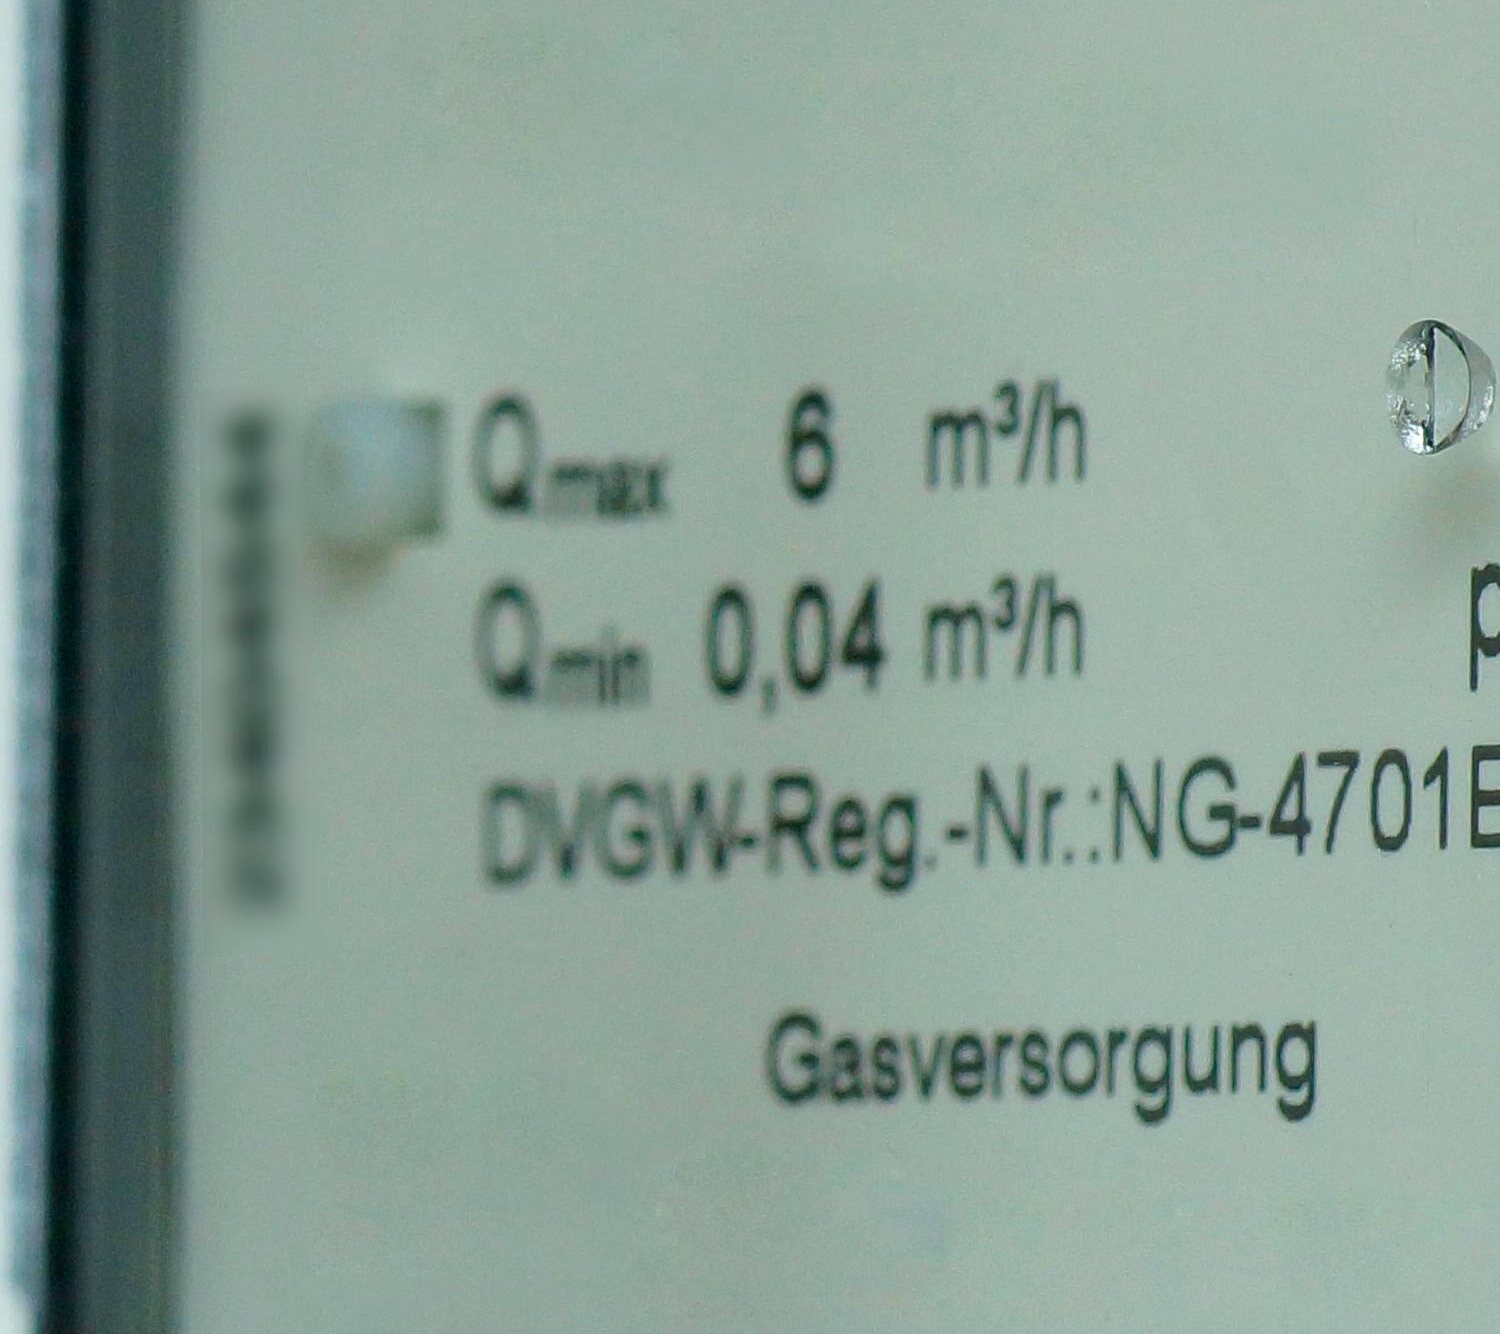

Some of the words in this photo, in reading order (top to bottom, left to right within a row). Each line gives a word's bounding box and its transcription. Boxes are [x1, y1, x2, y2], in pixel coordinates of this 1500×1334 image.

[474, 393, 670, 521] Qmax
[784, 387, 838, 505] 6
[925, 380, 1088, 490] m³/h
[474, 583, 650, 709] Qmin
[702, 579, 888, 717] 0,04
[922, 576, 1085, 682] m³/h
[764, 1010, 1316, 1126] Gasversorgung
